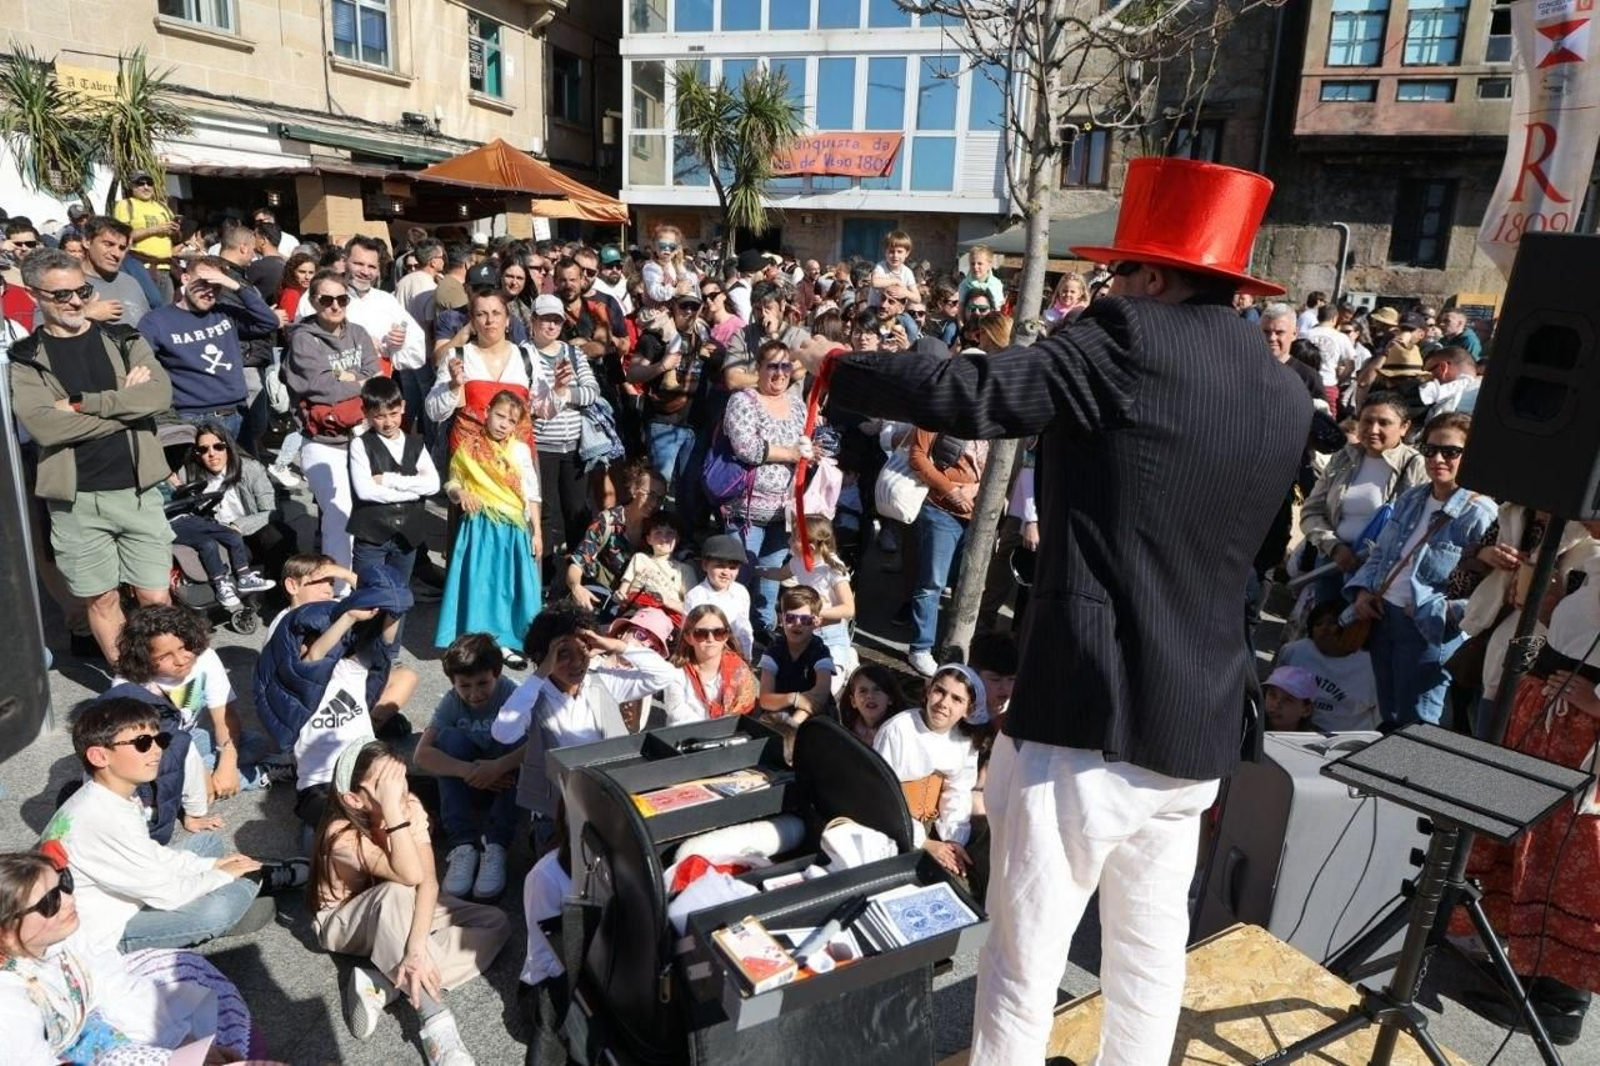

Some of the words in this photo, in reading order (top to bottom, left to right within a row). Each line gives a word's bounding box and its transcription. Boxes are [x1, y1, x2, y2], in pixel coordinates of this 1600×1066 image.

[872, 138, 890, 151] da
[801, 155, 816, 169] de
[1508, 120, 1572, 203] R
[1490, 211, 1569, 243] 1809
